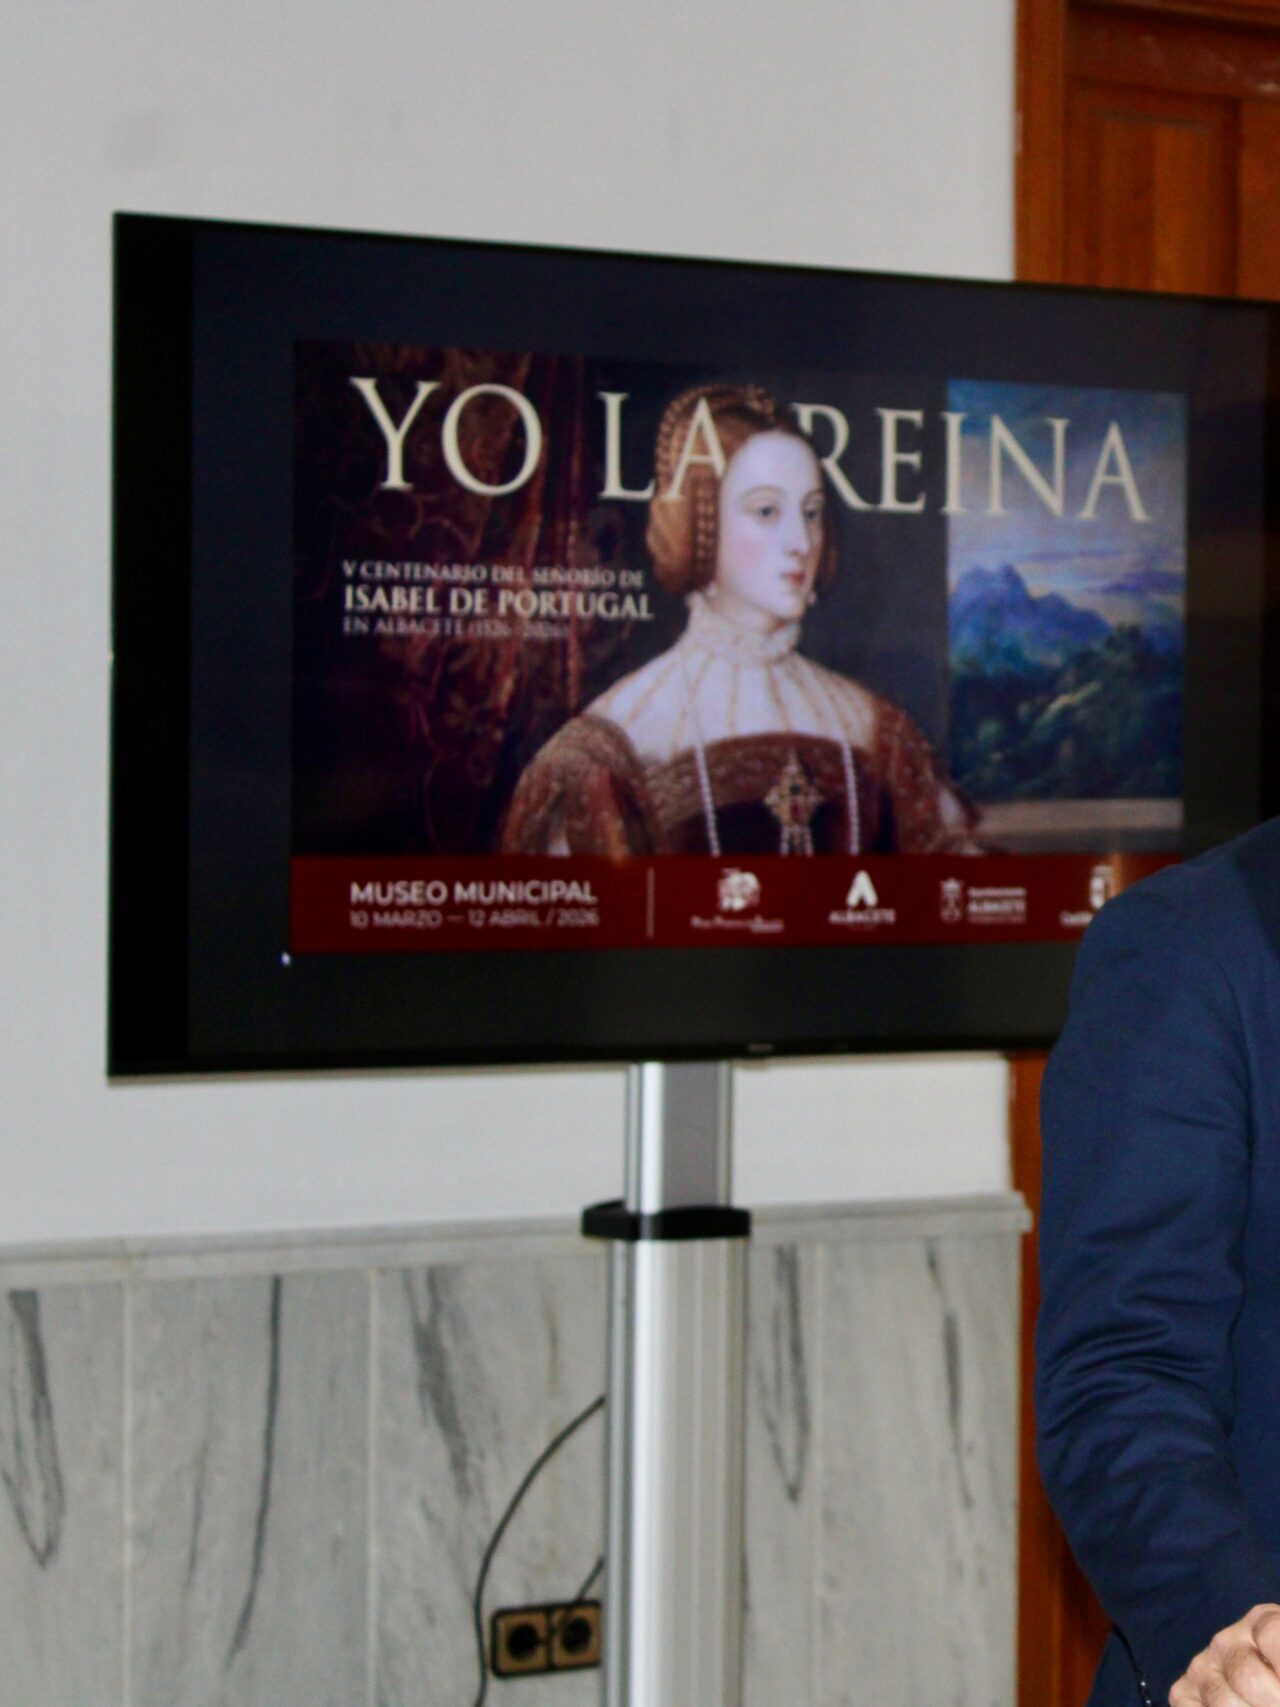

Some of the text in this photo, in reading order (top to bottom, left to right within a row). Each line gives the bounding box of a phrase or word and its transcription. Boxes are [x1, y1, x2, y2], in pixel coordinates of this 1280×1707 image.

[349, 376, 1155, 522] YO LA REINA
[342, 560, 357, 578] V
[360, 560, 488, 582] CENTENARIO
[491, 564, 525, 585] DEL
[619, 569, 645, 589] DE
[344, 583, 654, 621] ISABEL DE PORTUGAL
[342, 615, 368, 635] EN
[350, 879, 598, 905] MUSEO MUNICIPAL
[350, 908, 369, 928] 10
[372, 908, 443, 929] MARZO
[489, 908, 540, 928] ABRIL
